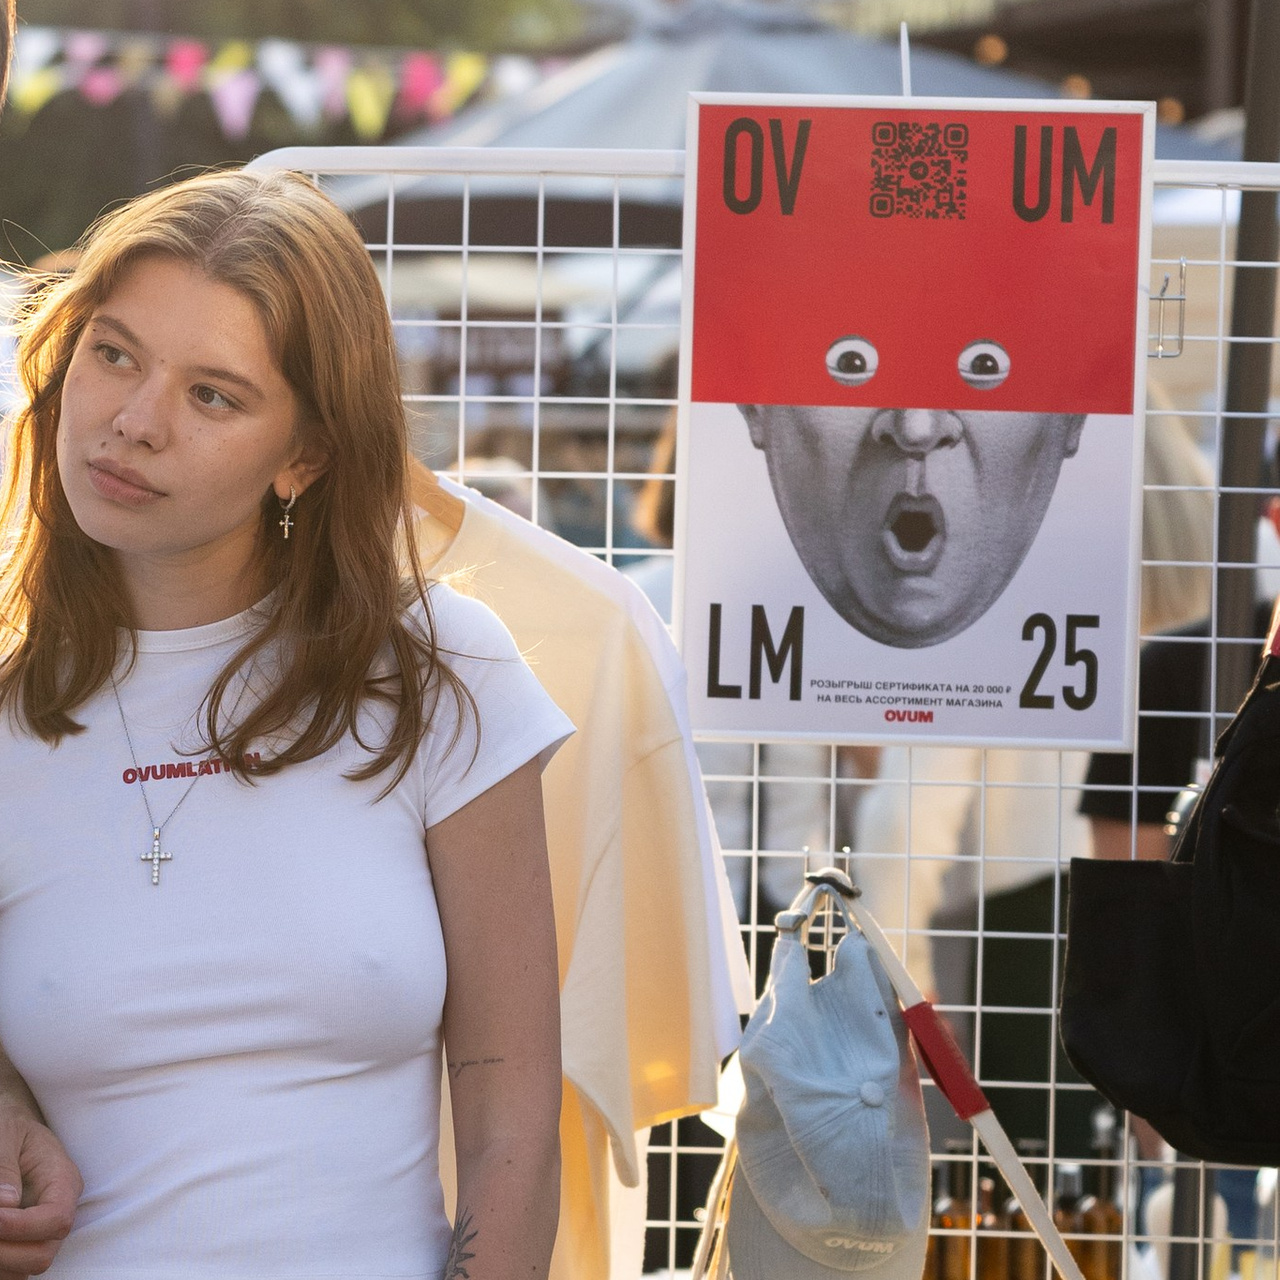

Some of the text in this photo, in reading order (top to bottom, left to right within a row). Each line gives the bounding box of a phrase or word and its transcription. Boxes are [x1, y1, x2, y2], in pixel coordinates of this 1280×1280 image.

[723, 117, 1117, 223] OV UM
[707, 603, 1100, 711] LM 25
[810, 680, 872, 690] РОЗЫГРЫШ
[875, 682, 952, 692] СЕРТИФИКАТА
[972, 685, 984, 693] 20
[986, 686, 1004, 694] 000
[817, 694, 1002, 708] НА ВЕСЬ АССОРТИМЕНТ МАГАЗИНА
[884, 710, 934, 722] OVUM
[122, 752, 261, 784] OVUMLATIN
[824, 1237, 894, 1254] OVUM
